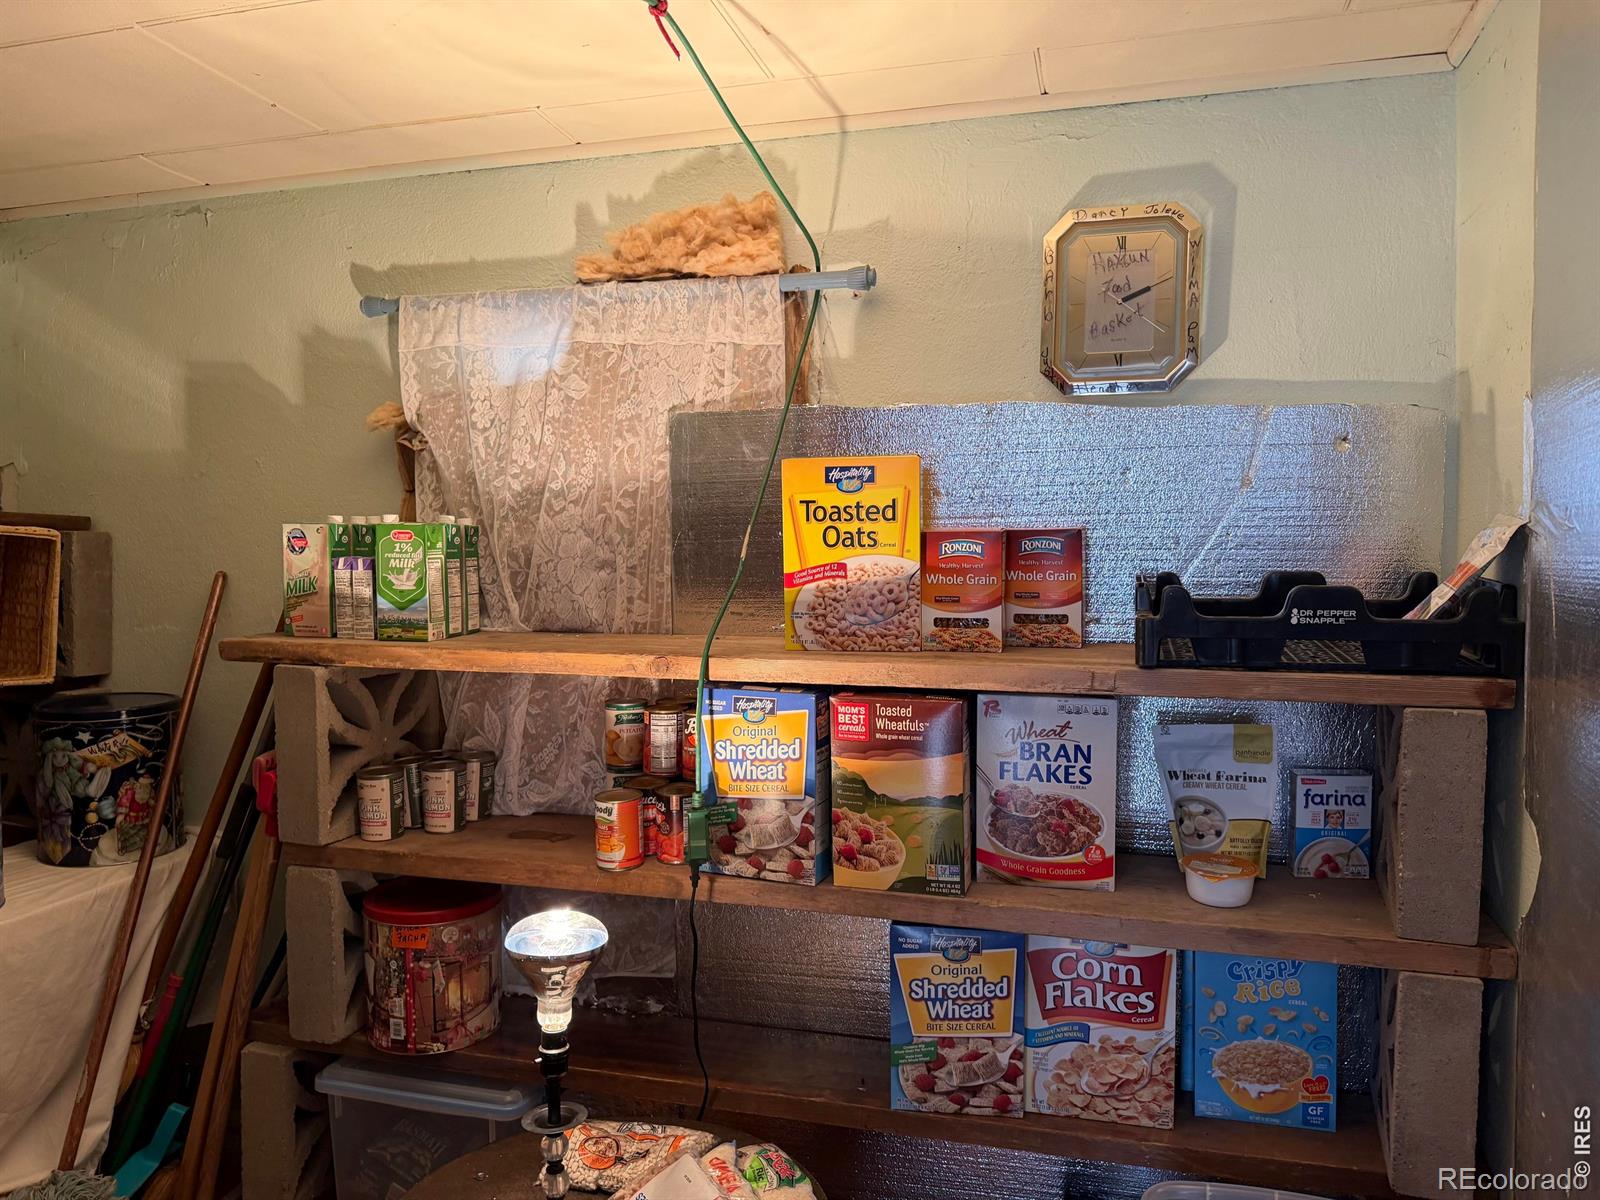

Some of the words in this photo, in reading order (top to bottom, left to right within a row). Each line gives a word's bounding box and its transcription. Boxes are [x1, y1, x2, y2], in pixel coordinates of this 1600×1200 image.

[829, 467, 871, 482] Hospitality
[800, 498, 897, 523] Toasted
[822, 525, 879, 548] Oats
[393, 543, 413, 552] 1%
[941, 542, 982, 555] RONZONI
[1021, 541, 1061, 552] RONZONI
[389, 558, 415, 568] Milk
[824, 569, 845, 578] Minerals
[926, 574, 963, 585] Whole
[966, 574, 997, 585] Grain
[1006, 570, 1043, 581] Whole
[1046, 570, 1077, 581] Grain
[286, 577, 318, 597] MILK
[837, 706, 866, 714] MOM'S
[875, 703, 912, 717] Toasted
[838, 714, 866, 724] BEST
[733, 725, 777, 739] Original
[838, 724, 866, 732] cereals
[1005, 720, 1073, 744] Wheat
[715, 738, 801, 760] Shredded
[1019, 741, 1092, 764] BRAN
[728, 761, 786, 780] Wheat
[999, 761, 1093, 785] FLAKES
[1168, 769, 1211, 781] Wheat
[1215, 771, 1267, 784] Farina
[728, 784, 743, 792] BITE
[745, 784, 761, 792] SIZE
[762, 784, 789, 792] CEREAL
[1183, 781, 1203, 789] CREAMY
[1205, 782, 1224, 790] WHEAT
[1225, 783, 1248, 791] CEREAL
[1304, 788, 1366, 808] farina
[1001, 858, 1024, 871] Whole
[1026, 864, 1047, 874] Grain
[1049, 866, 1086, 876] Goodness
[931, 964, 982, 978] Original
[1051, 952, 1143, 986] Corn
[1226, 960, 1305, 982] Crispy
[910, 977, 1008, 999] Shredded
[1233, 979, 1301, 1003] Rice
[1043, 980, 1155, 1014] Flakes
[927, 1000, 992, 1019] Wheat
[926, 1022, 943, 1031] BITE
[946, 1023, 964, 1031] SIZE
[965, 1022, 996, 1031] CEREAL
[1308, 1106, 1324, 1116] GF
